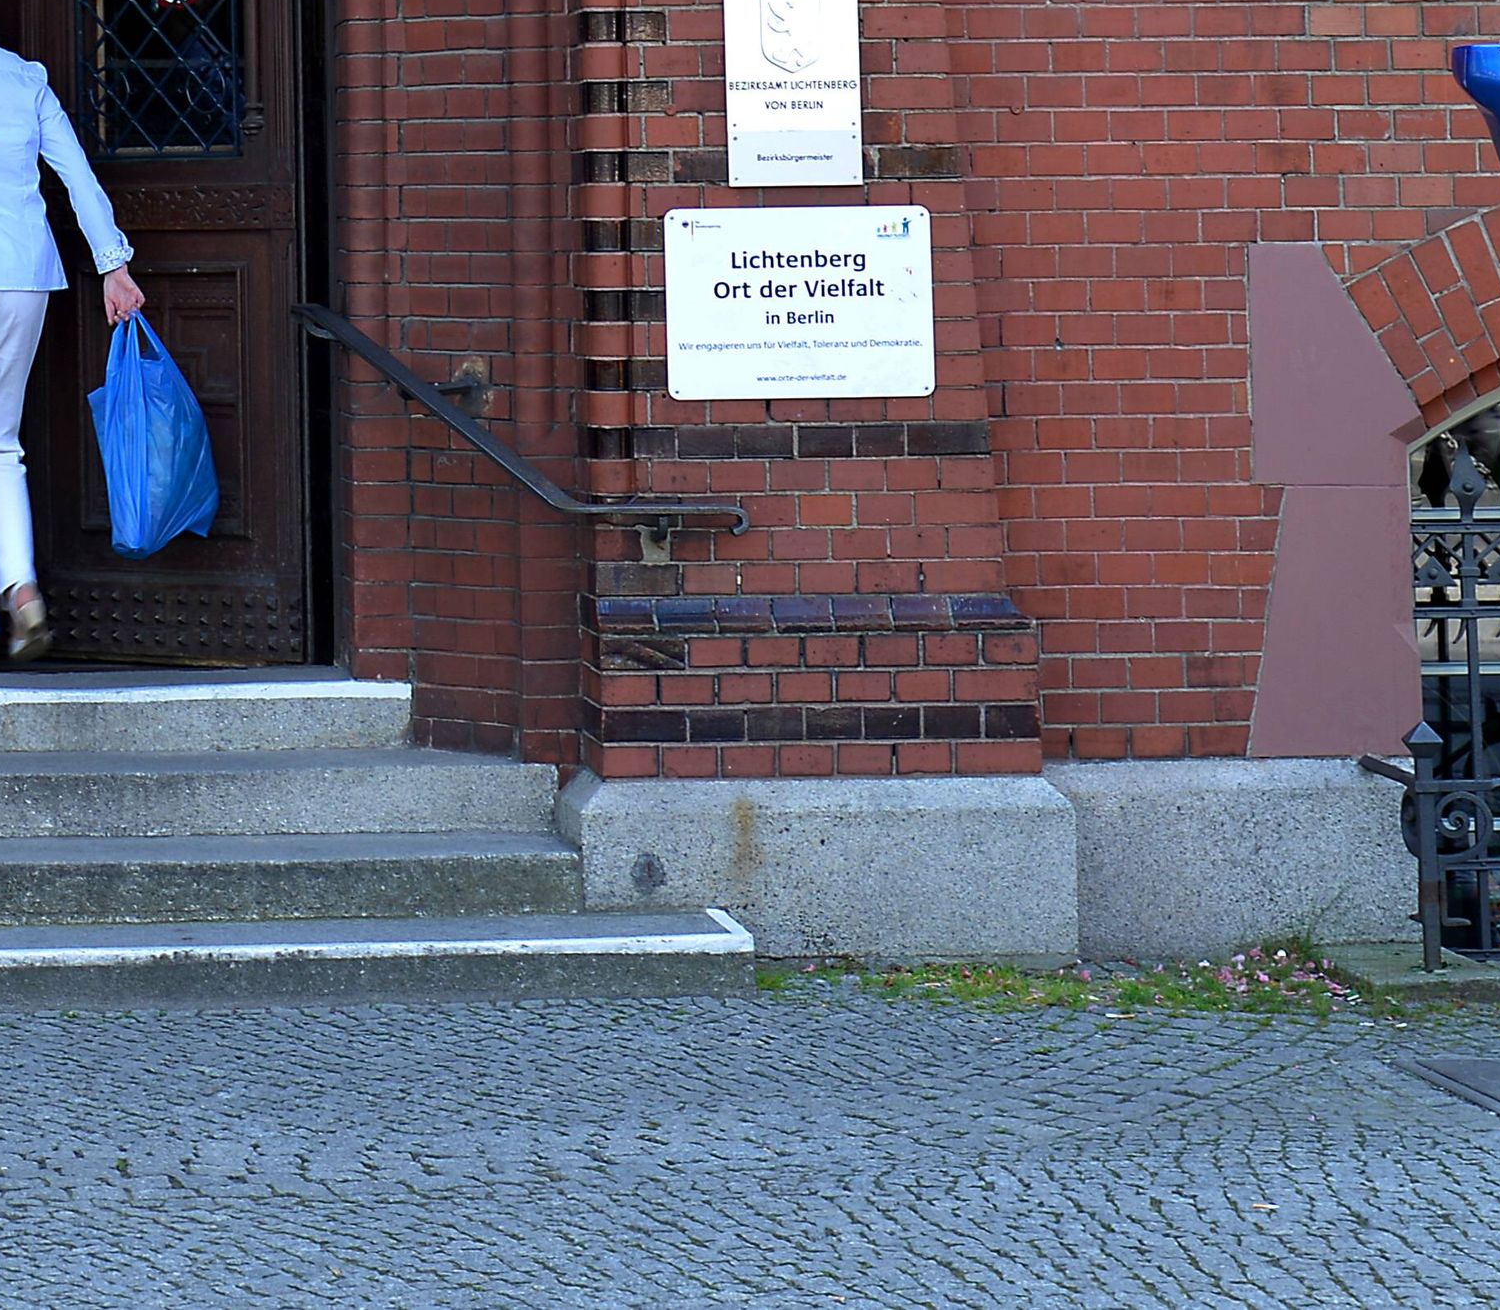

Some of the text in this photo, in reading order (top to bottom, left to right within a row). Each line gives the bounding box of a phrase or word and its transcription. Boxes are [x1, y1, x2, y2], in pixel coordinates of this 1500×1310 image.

[729, 80, 858, 91] BEZIRKSAMT LICHTENBERG
[765, 100, 823, 110] VON BERLIN
[757, 154, 834, 163] Bezirksbürgermeister
[731, 249, 866, 272] Lichtenberg
[714, 278, 885, 299] Ort der Vielfalt
[765, 310, 835, 325] in Berlin
[678, 342, 694, 351] Wir
[695, 342, 745, 352] engagieren
[763, 340, 776, 349] für
[777, 340, 811, 349] Vielfalt,
[813, 340, 849, 348] Toleranz
[851, 339, 868, 347] und
[869, 338, 923, 347] Demokratie.
[756, 374, 847, 382] www.orte-der-vielfalt.de
